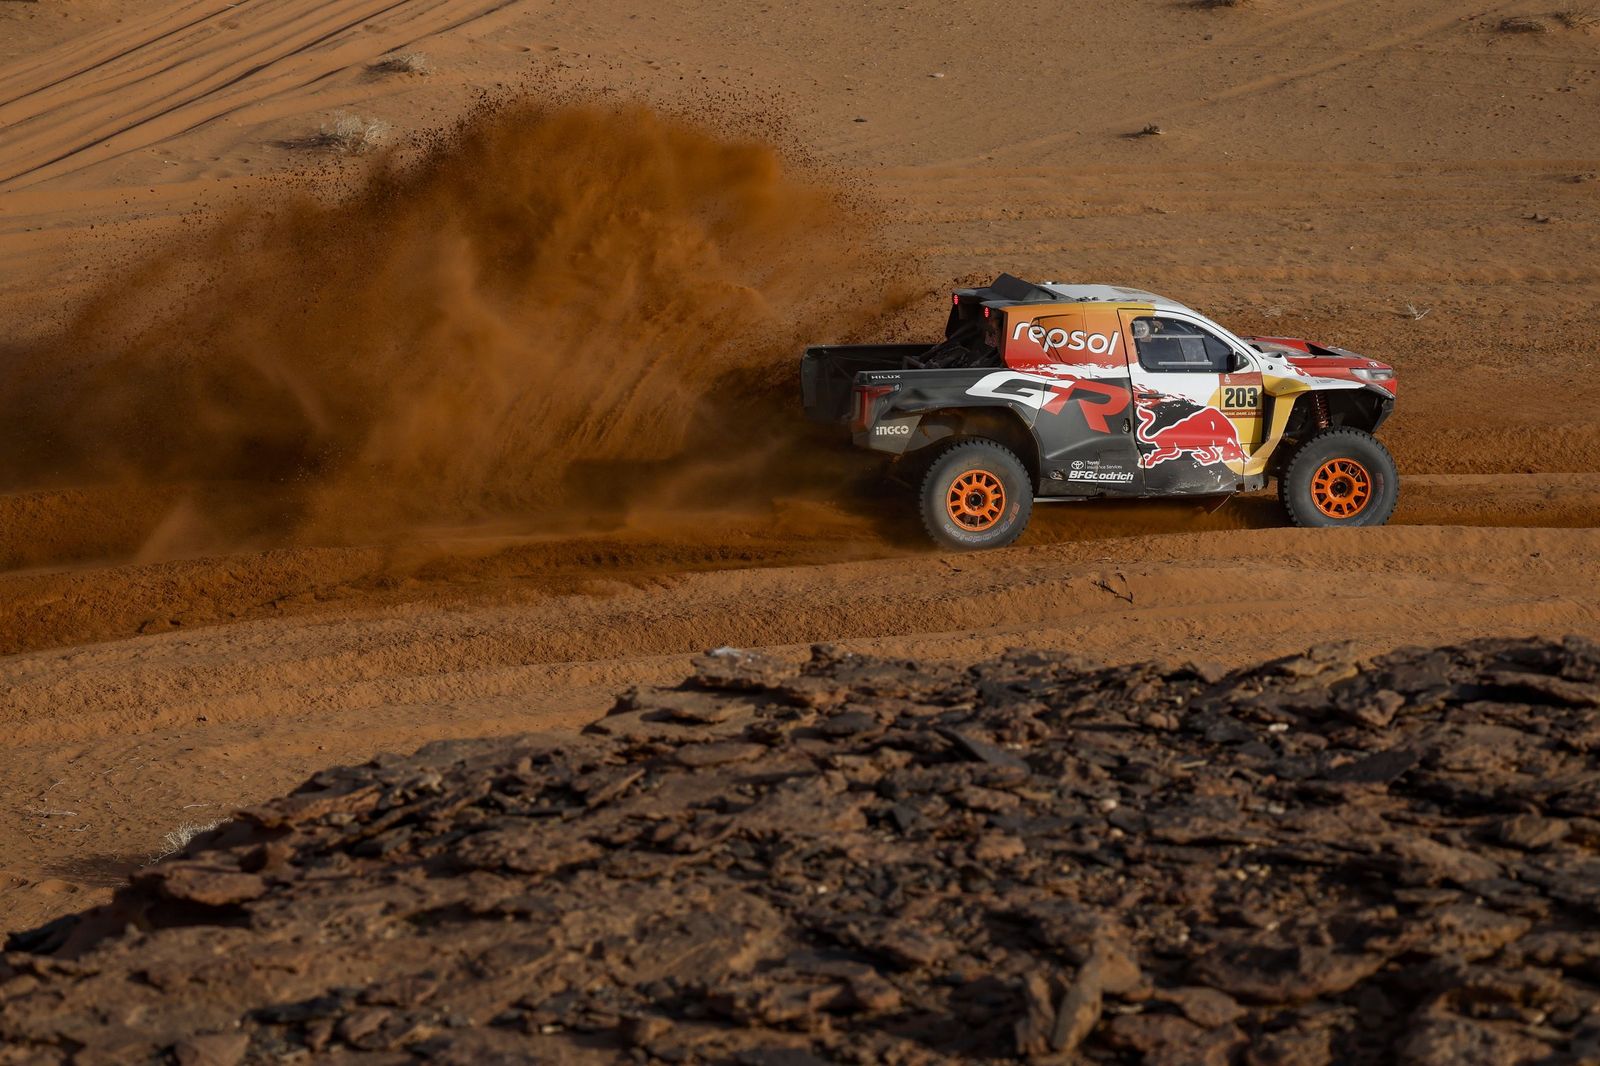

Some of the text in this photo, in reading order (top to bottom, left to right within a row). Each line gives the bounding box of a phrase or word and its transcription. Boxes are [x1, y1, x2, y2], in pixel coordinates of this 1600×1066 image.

[1013, 322, 1119, 356] repsol
[965, 371, 1132, 434] GR
[1224, 387, 1258, 408] 203
[1069, 470, 1134, 480] BFGoodrich
